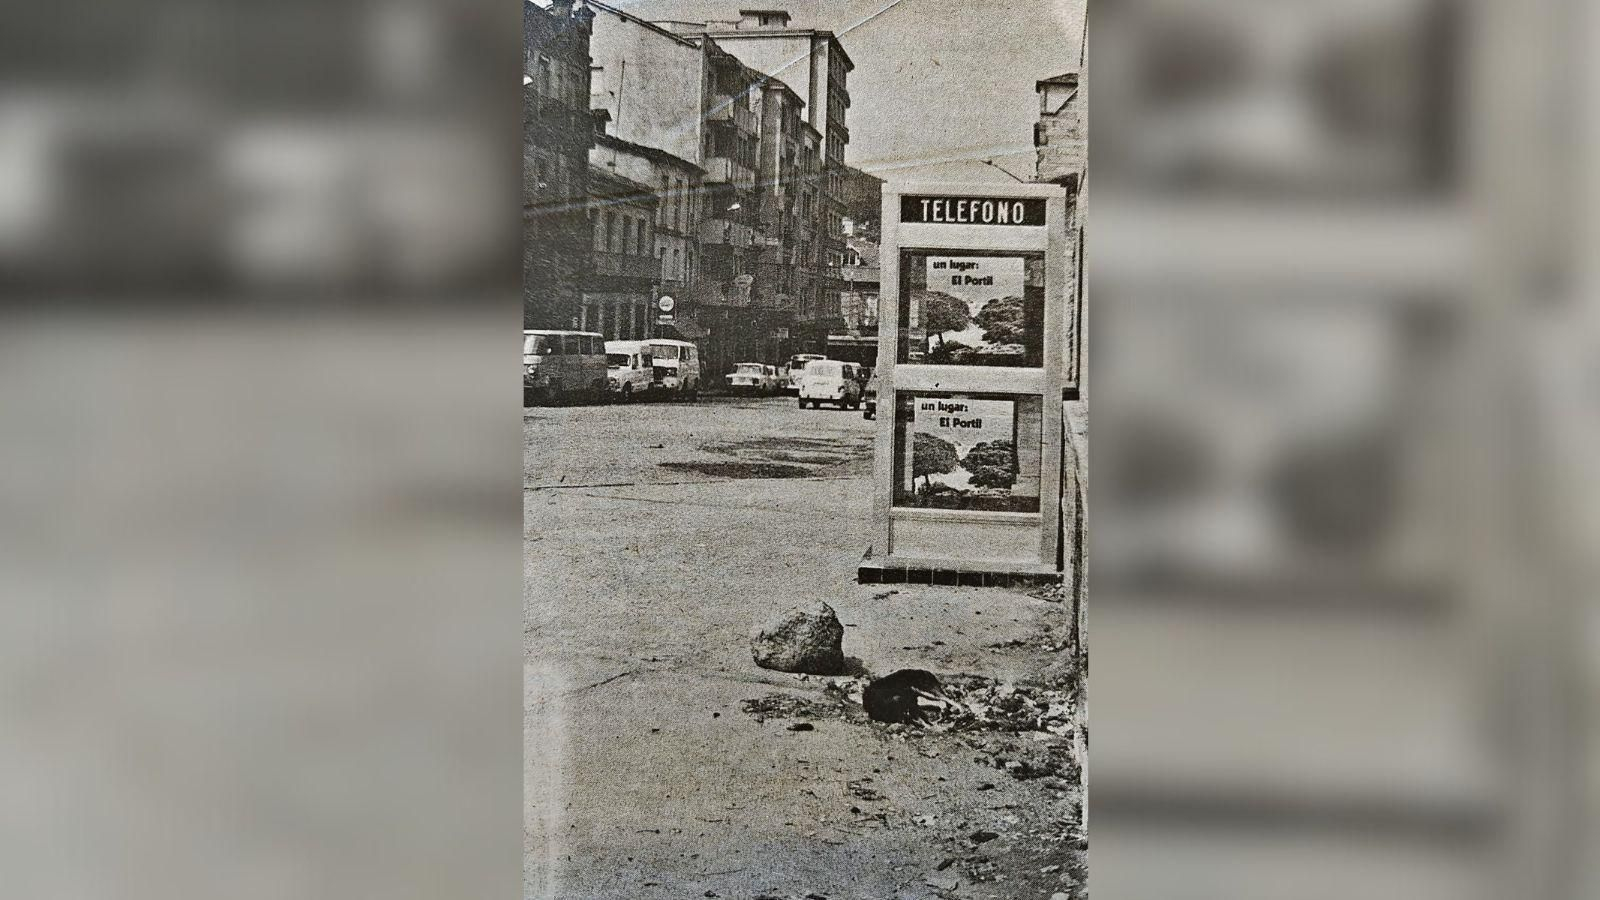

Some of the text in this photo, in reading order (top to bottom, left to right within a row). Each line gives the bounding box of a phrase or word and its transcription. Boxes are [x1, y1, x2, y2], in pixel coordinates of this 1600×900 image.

[921, 199, 1024, 224] TELEFONO
[932, 259, 979, 271] un lugar:
[951, 275, 993, 286] El Portil
[921, 401, 968, 413] un lugar:
[939, 417, 982, 429] El Portil
